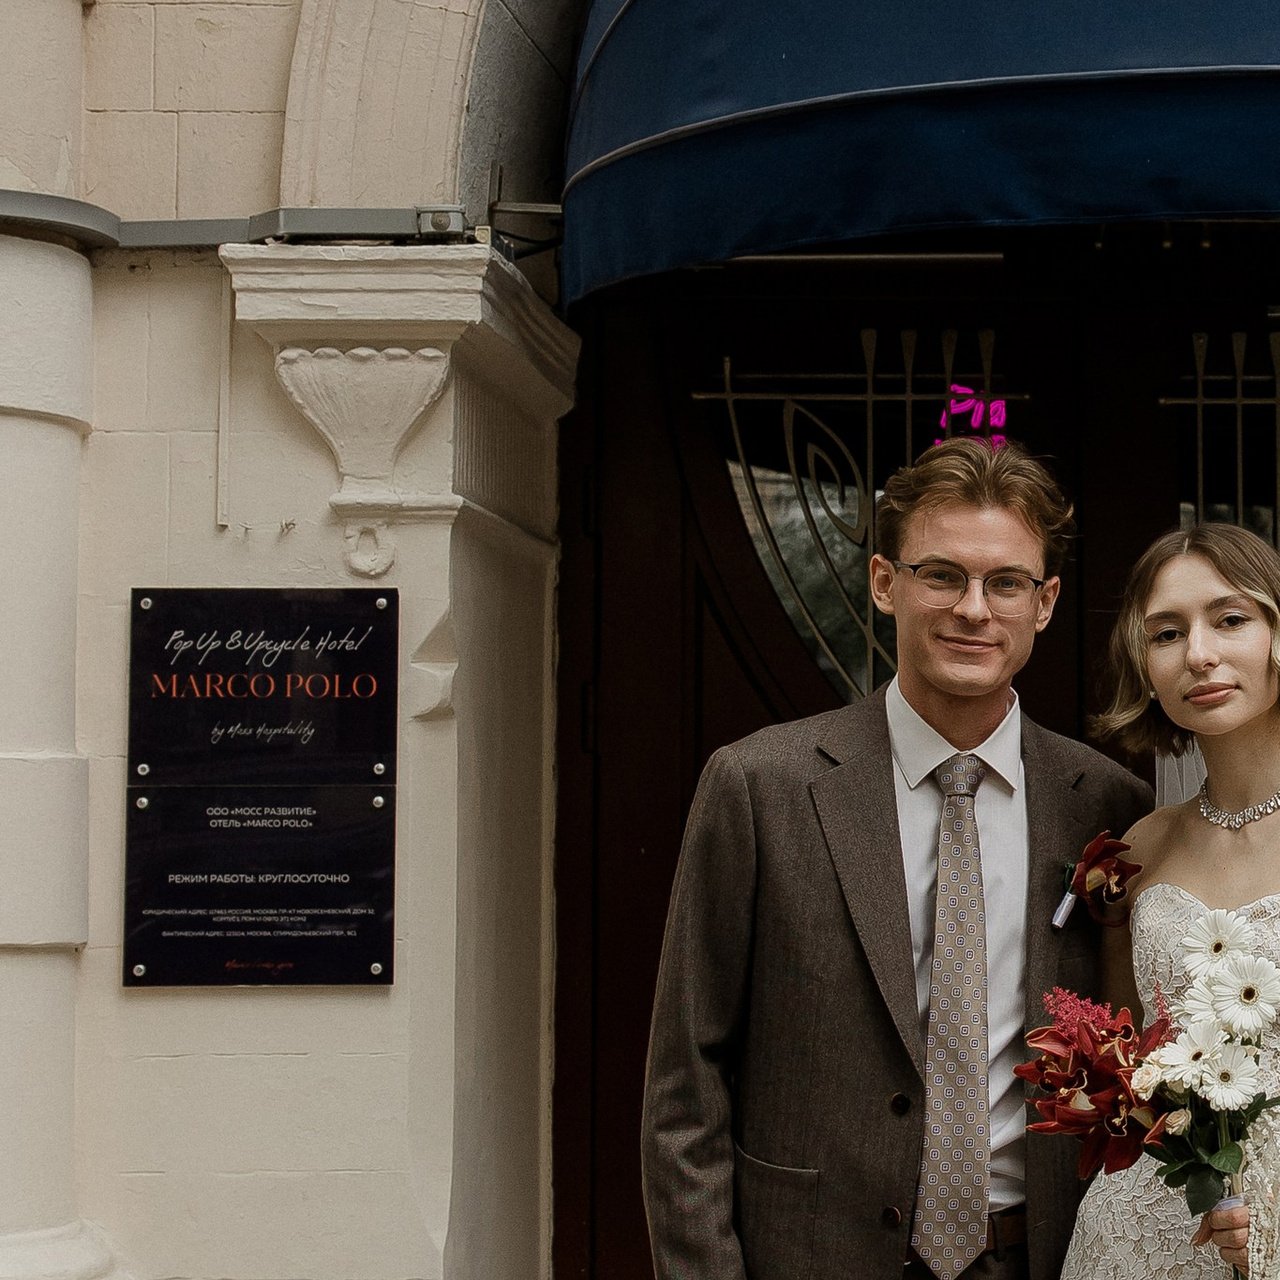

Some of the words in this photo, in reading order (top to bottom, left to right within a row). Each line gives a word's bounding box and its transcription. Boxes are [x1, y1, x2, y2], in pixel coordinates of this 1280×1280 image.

[164, 630, 194, 665] Pop
[196, 631, 222, 665] Up
[225, 630, 243, 650] &
[243, 626, 310, 668] Upcycle
[315, 626, 373, 660] Hotel
[151, 673, 275, 699] MARCO
[286, 673, 377, 699] POLO
[256, 721, 315, 744] Hospitality
[206, 807, 229, 816] ООО
[263, 807, 317, 816] РАЗВИТИЕ»
[209, 819, 241, 828] ОТЕЛЬ
[168, 874, 208, 884] РЕЖИМ
[209, 874, 256, 884] РАБОТЫ:
[258, 874, 350, 884] КРУГЛОСУТОЧНО
